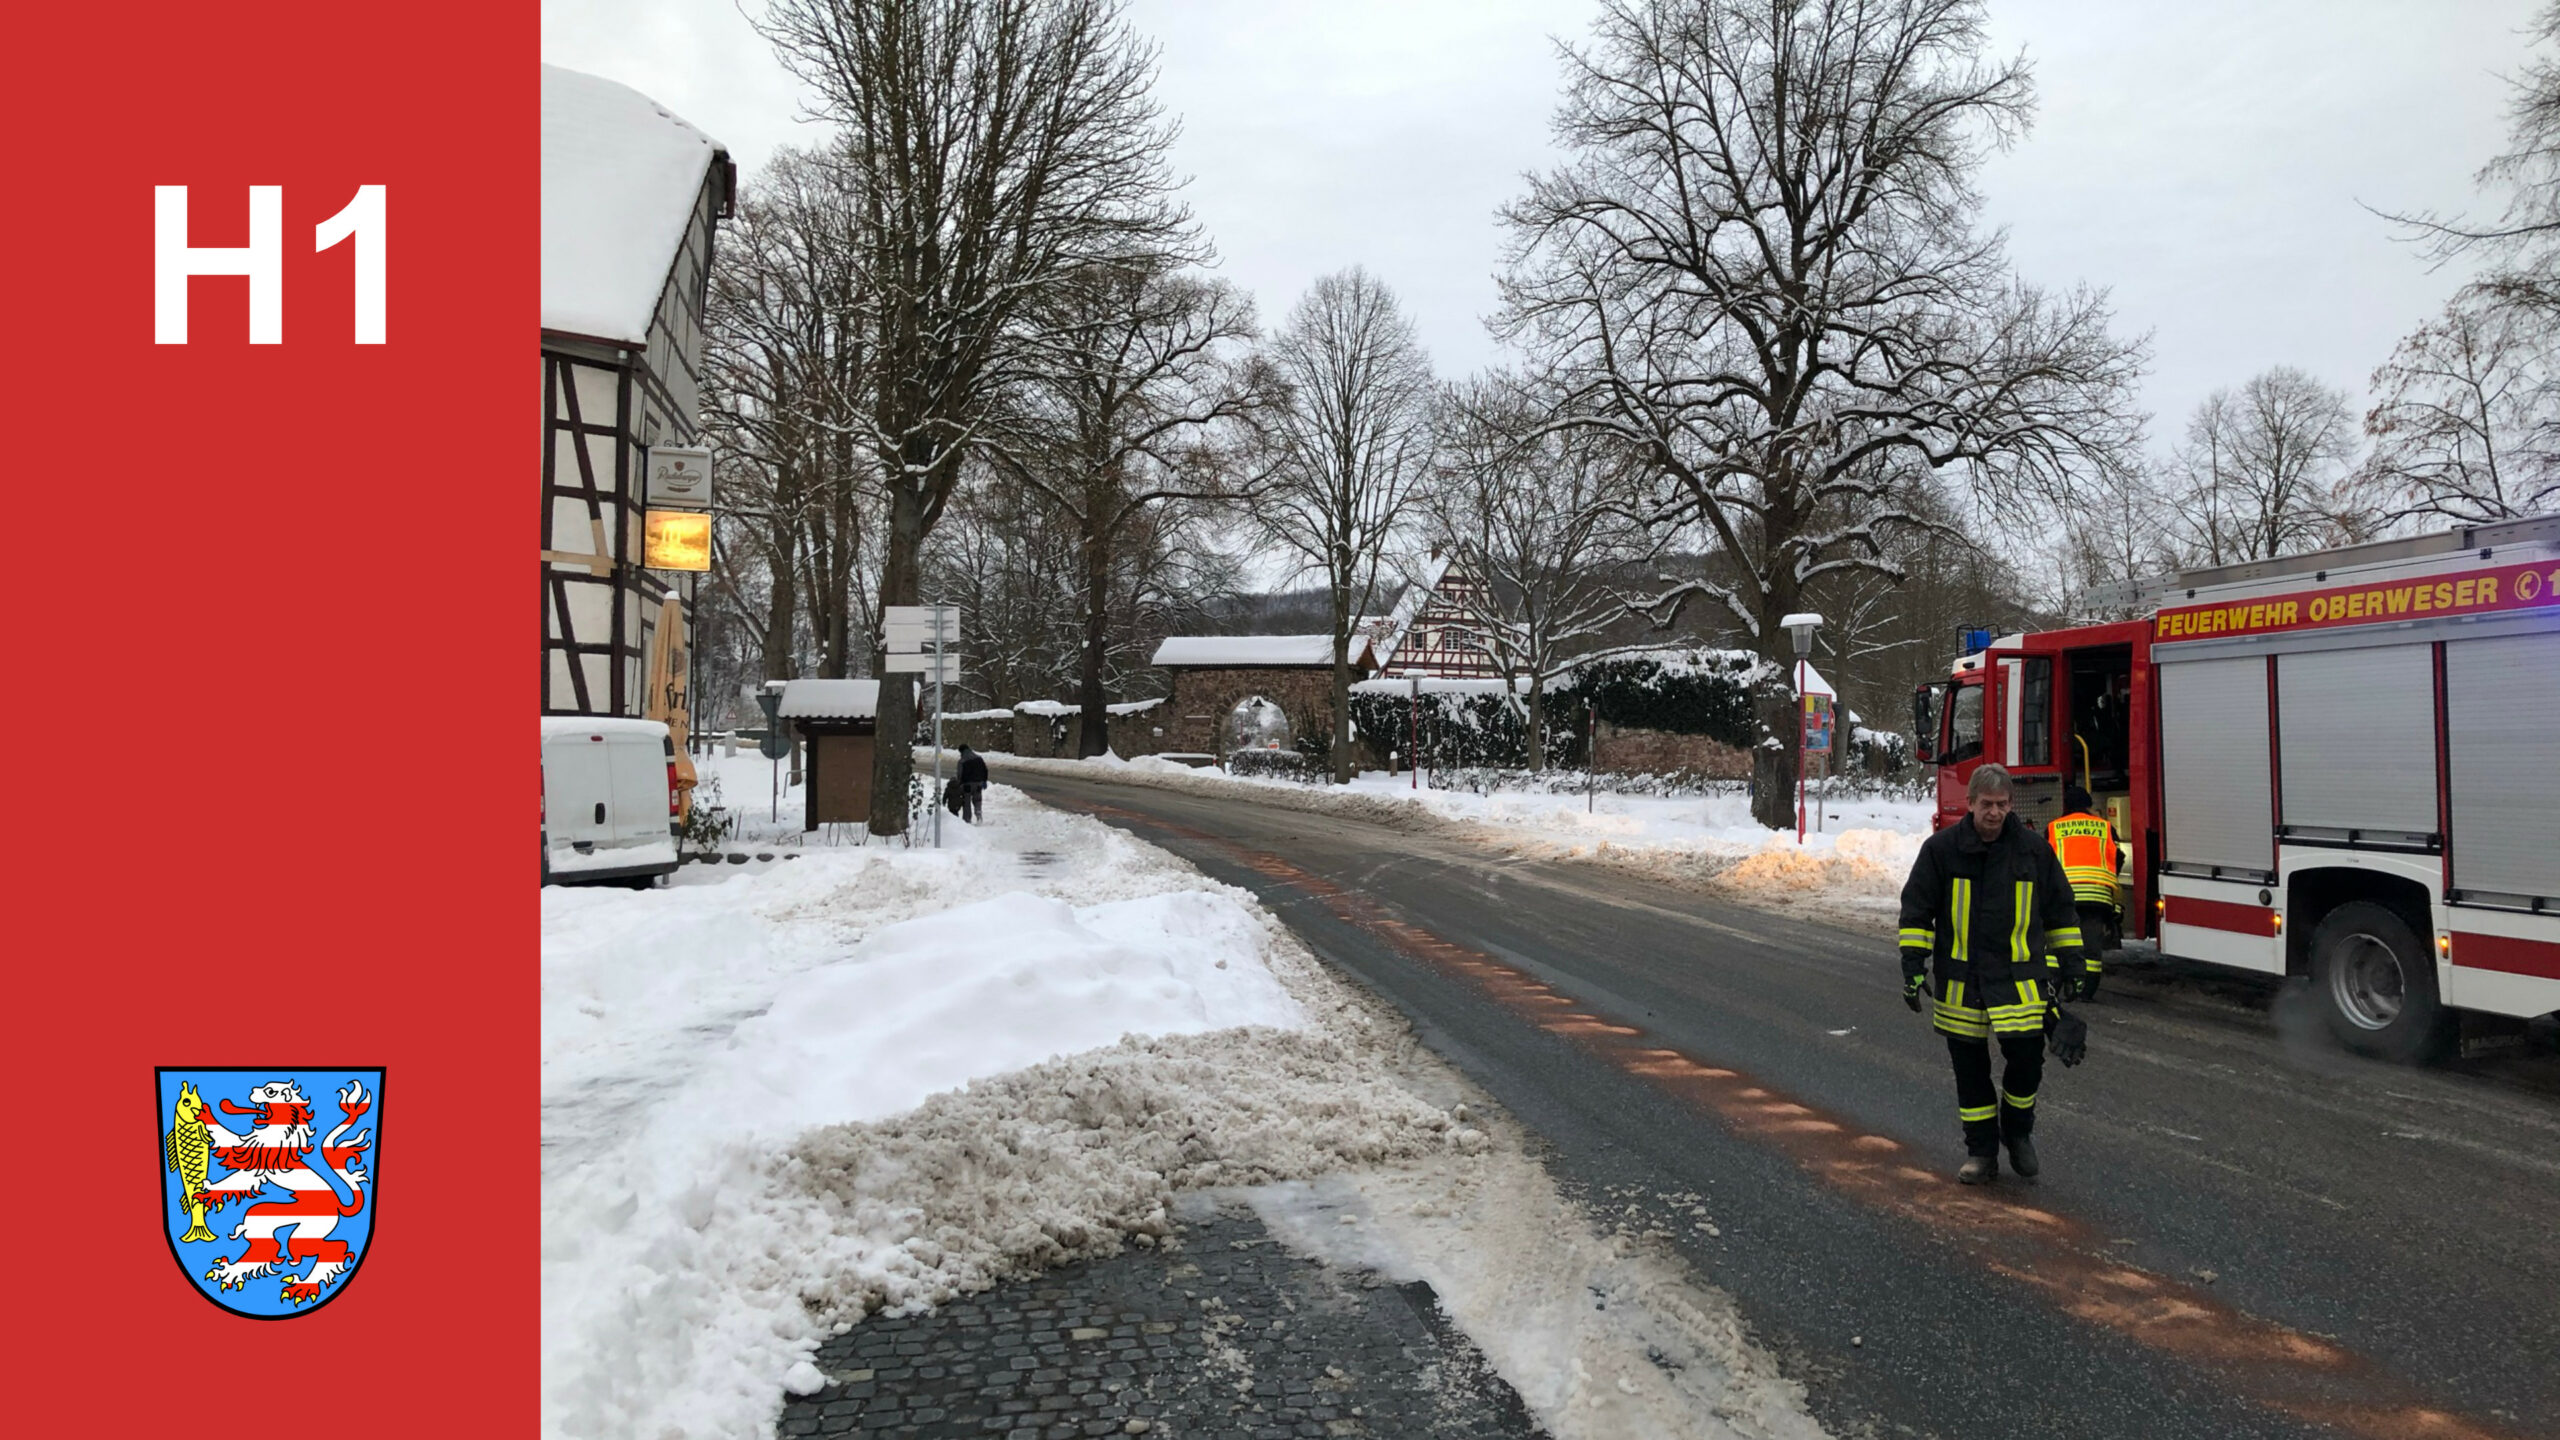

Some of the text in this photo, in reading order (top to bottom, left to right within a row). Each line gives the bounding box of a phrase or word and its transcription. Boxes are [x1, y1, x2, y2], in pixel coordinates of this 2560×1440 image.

[2157, 601, 2298, 637] FEUERWEHR
[2309, 577, 2499, 622] OBERWESER
[2056, 819, 2106, 829] OBERWESER
[2061, 828, 2102, 837] 3/46/1
